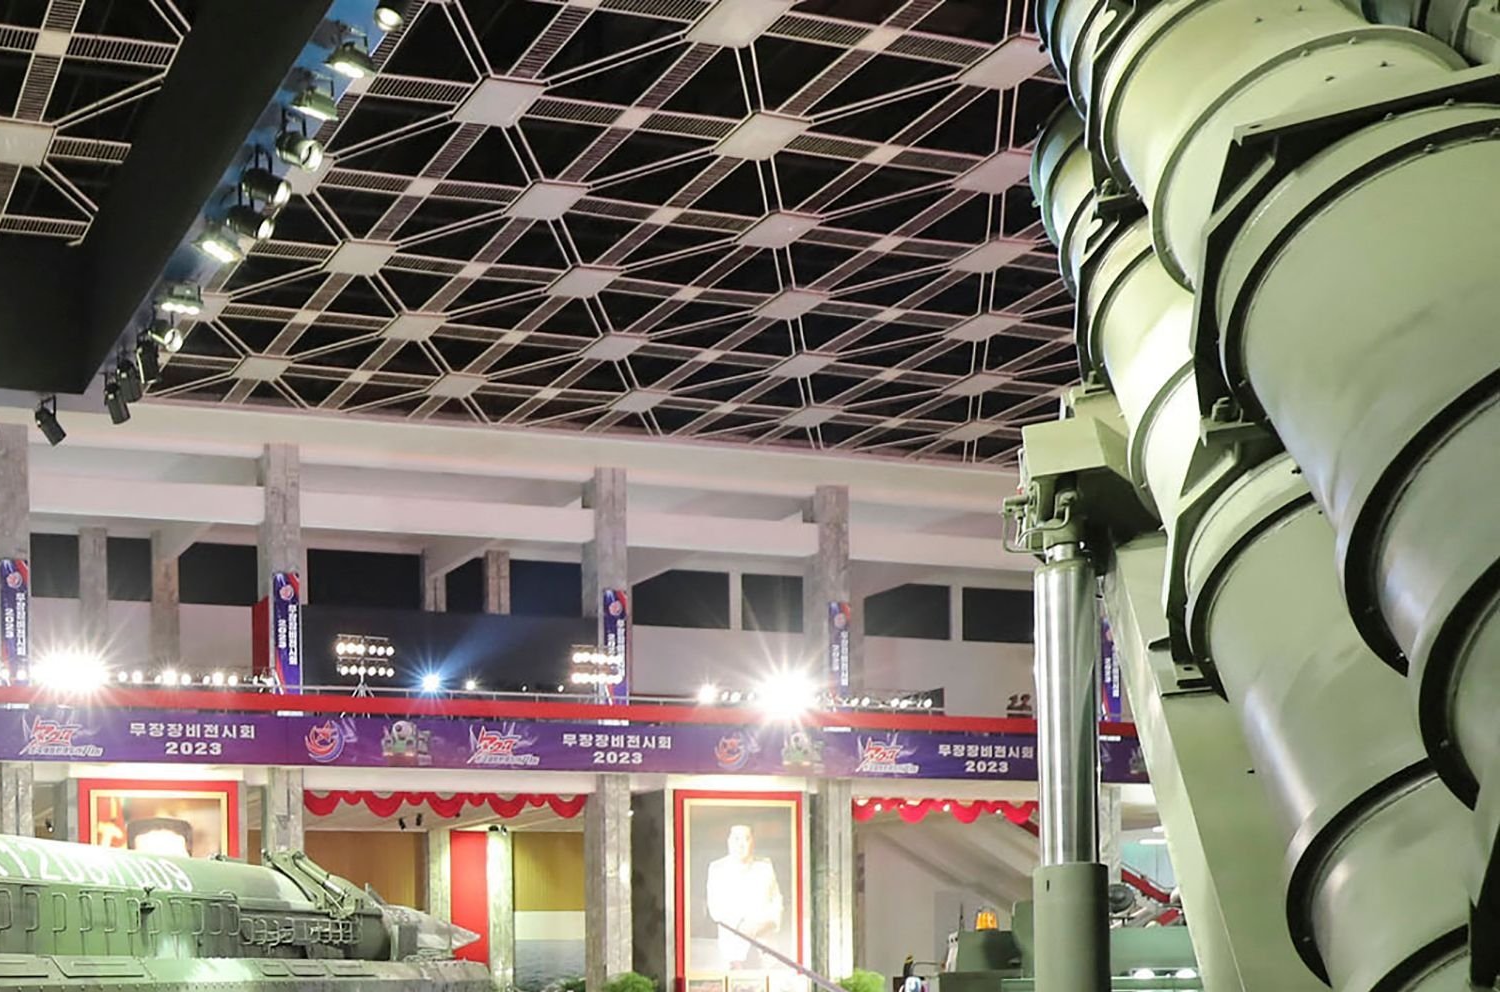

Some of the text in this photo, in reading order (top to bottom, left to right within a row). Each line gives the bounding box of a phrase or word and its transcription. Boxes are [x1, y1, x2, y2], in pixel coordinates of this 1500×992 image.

[129, 722, 255, 739] 무장장비전시회
[165, 741, 222, 755] 2023
[563, 733, 672, 749] 무장장비전시회
[593, 751, 643, 764] 2023
[965, 760, 1009, 773] 2023
